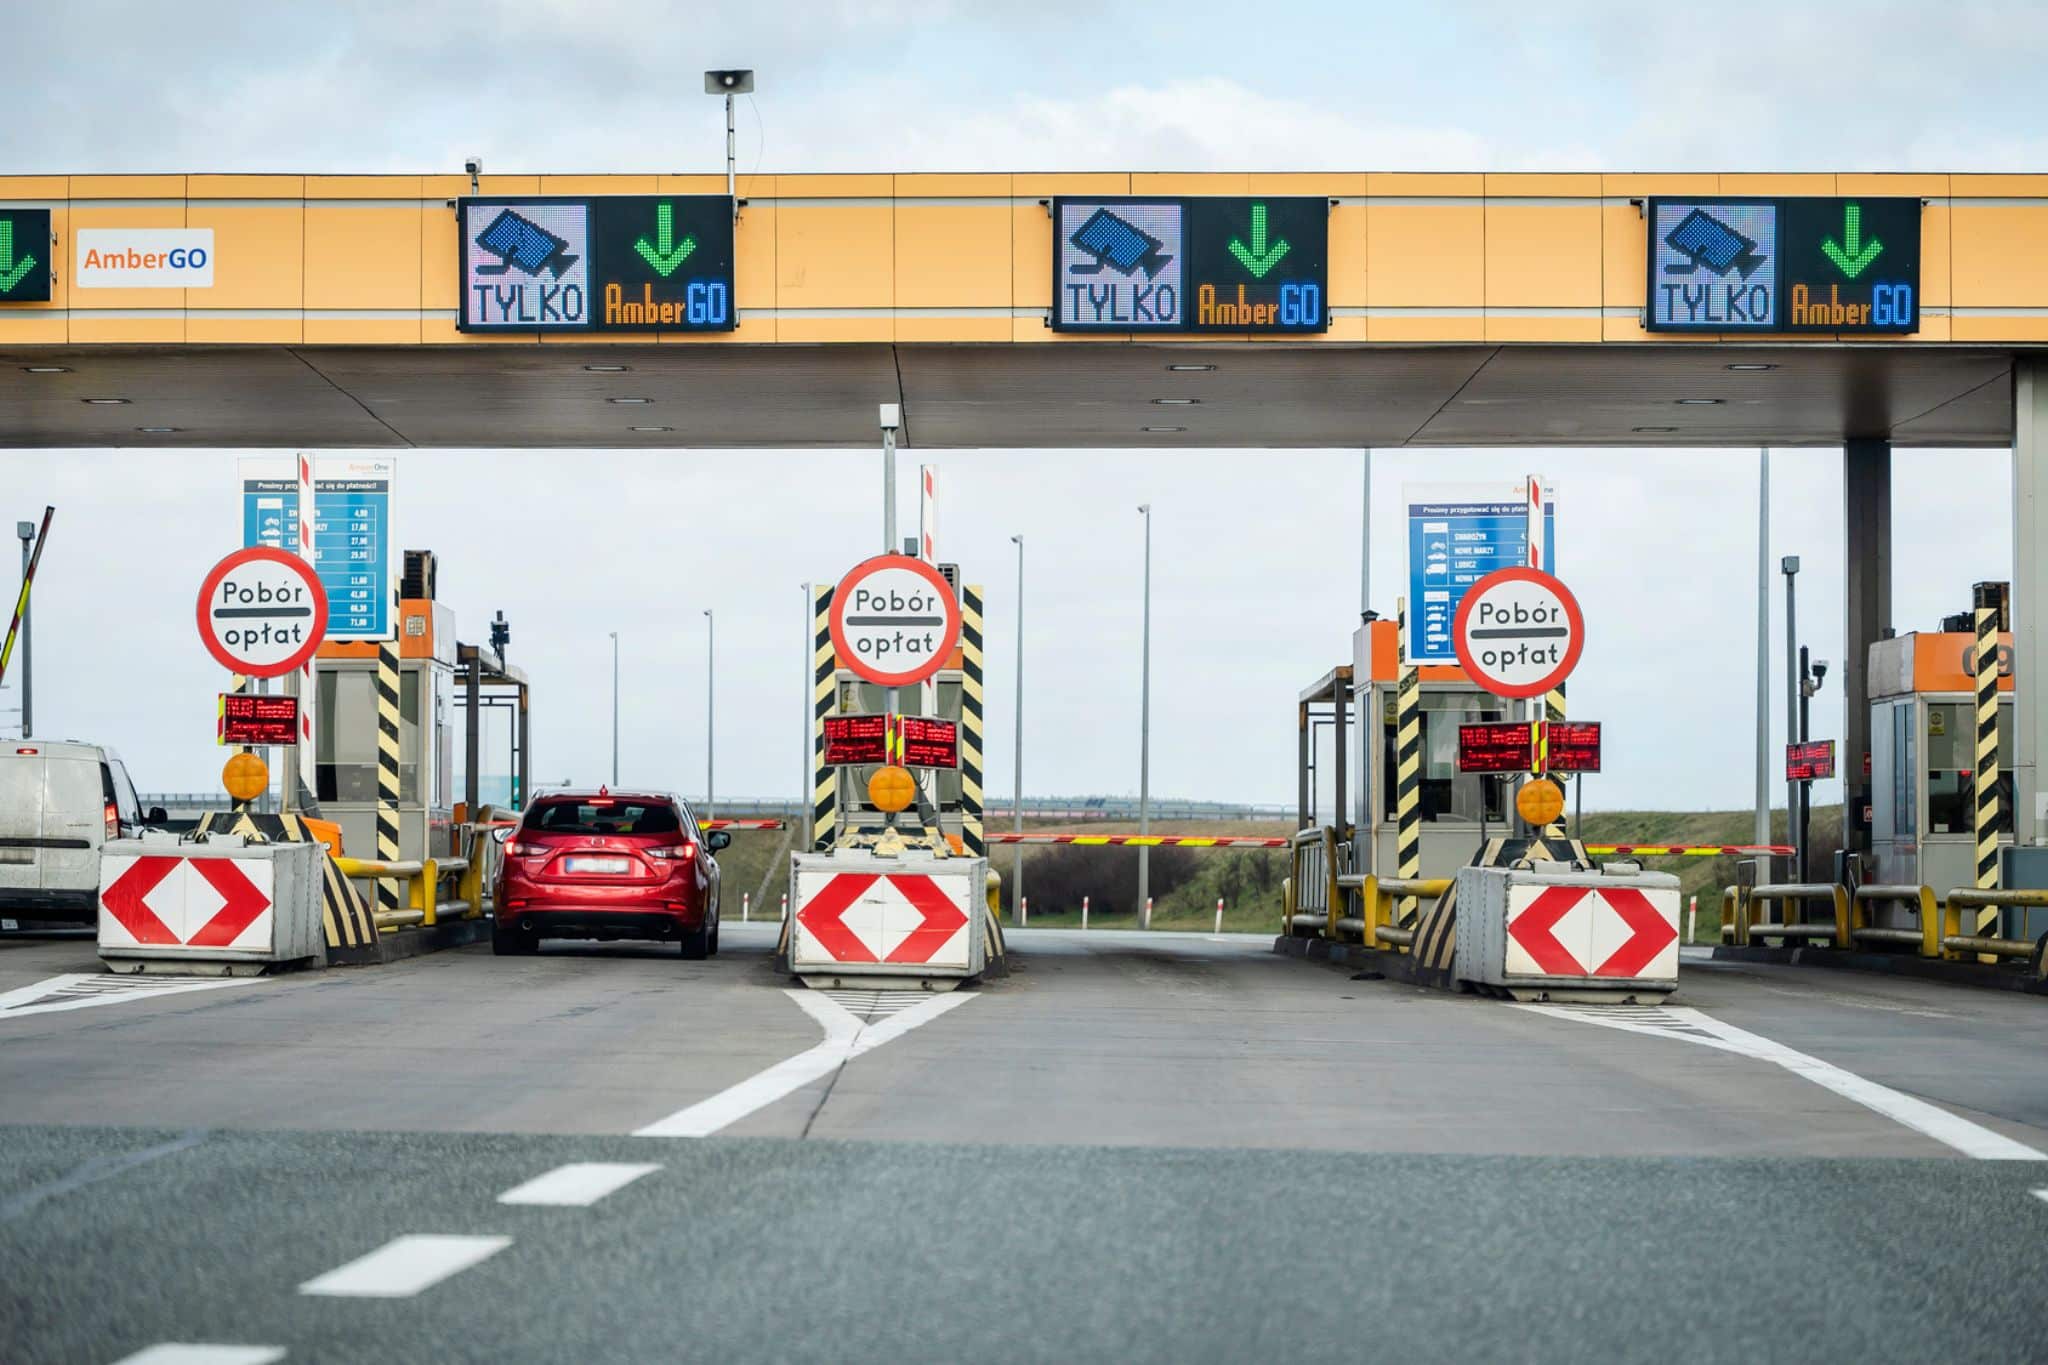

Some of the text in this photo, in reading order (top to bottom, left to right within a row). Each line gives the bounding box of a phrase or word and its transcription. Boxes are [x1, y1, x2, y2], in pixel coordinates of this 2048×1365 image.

[83, 248, 207, 269] AmberGO
[473, 284, 583, 322] TYLKO
[605, 283, 726, 324] AmberGO
[1066, 283, 1176, 322] TYLKO
[1199, 284, 1319, 325] AmberGO
[1661, 283, 1769, 322] TYLKO
[1792, 284, 1911, 325] AmberGO
[223, 580, 303, 604] Pobór
[856, 589, 935, 612] Pobór
[1480, 601, 1559, 625] Pobór
[225, 622, 302, 652] opłat
[857, 631, 933, 660] opłat
[1482, 643, 1558, 673] opłat
